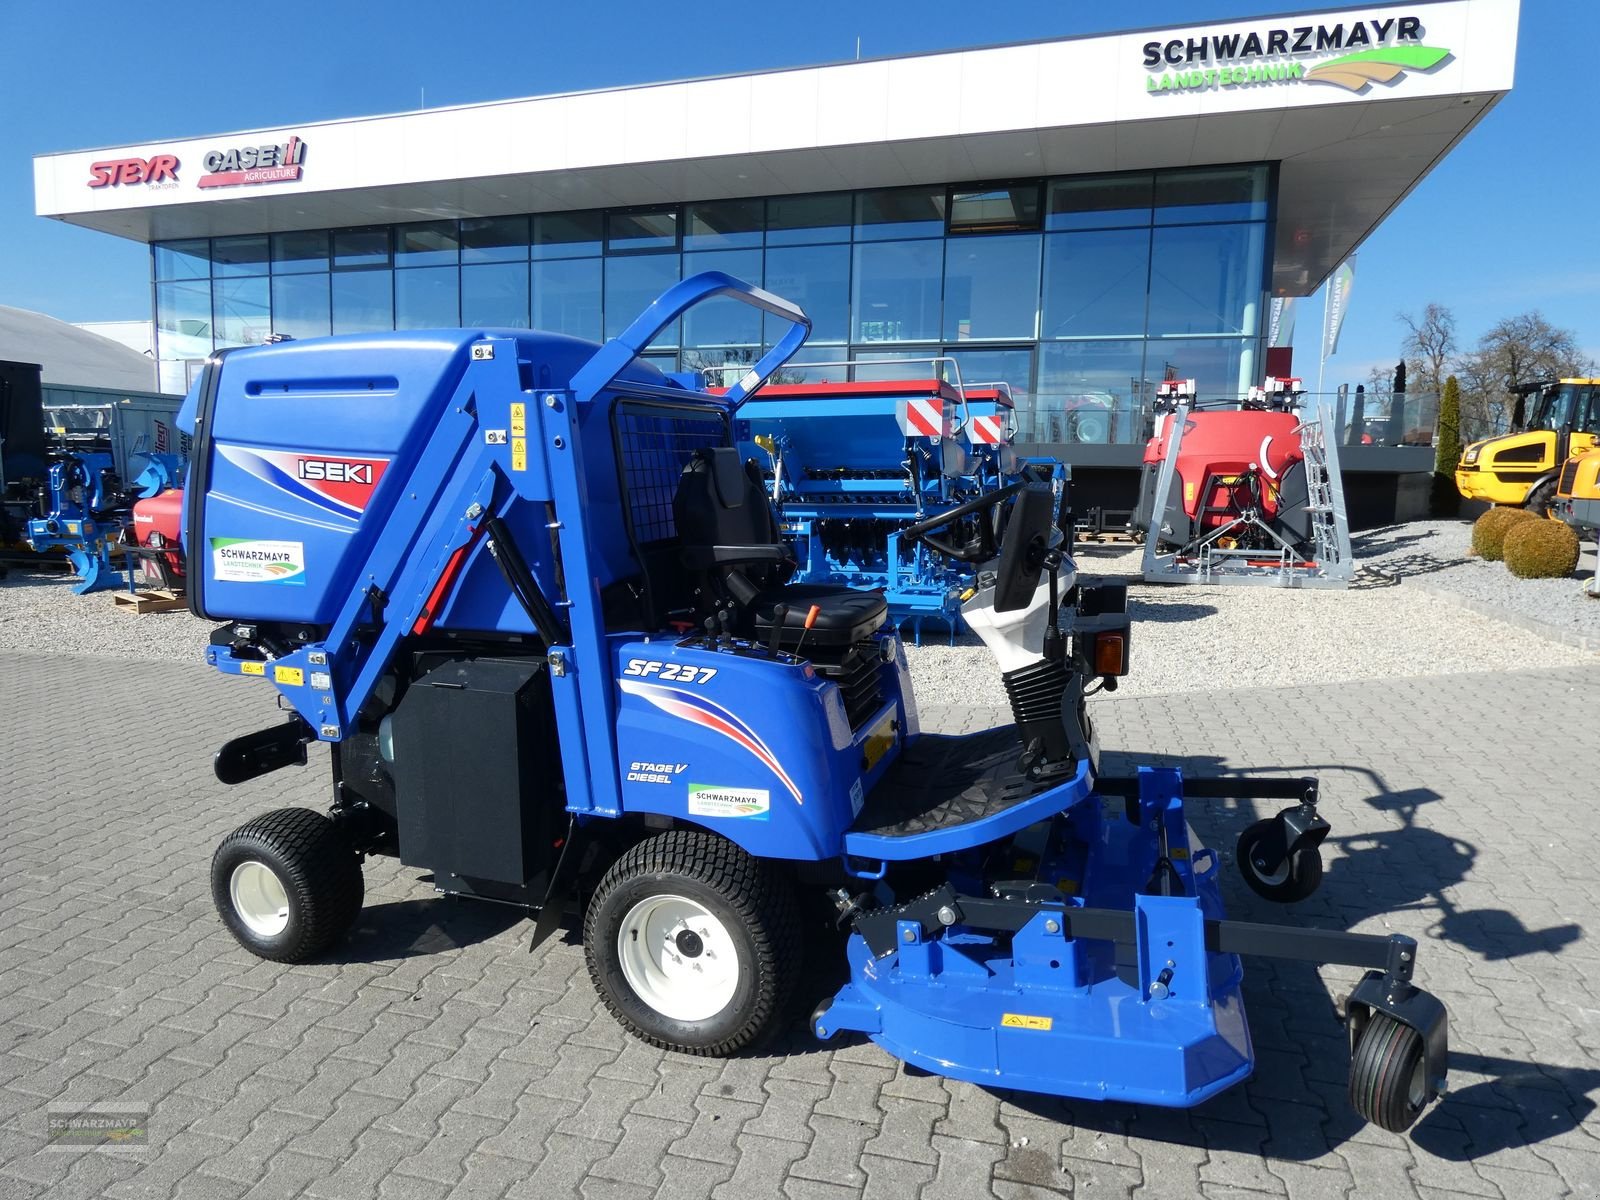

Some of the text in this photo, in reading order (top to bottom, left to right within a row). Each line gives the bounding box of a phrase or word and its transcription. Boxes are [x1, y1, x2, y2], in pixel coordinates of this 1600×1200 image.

[1142, 16, 1421, 68] SCHWARZMAYR
[1146, 62, 1303, 92] LANDTECHNIK
[87, 154, 179, 188] STEYR
[203, 144, 277, 173] CASE
[245, 168, 297, 182] AGRICULTURE
[298, 459, 373, 485] ISEKI
[220, 548, 290, 562] SCHWARZMAYR
[624, 658, 718, 685] SF237
[627, 772, 672, 784] DIESEL
[630, 762, 689, 774] STAGE V
[696, 792, 757, 804] SCHWARZMAYR
